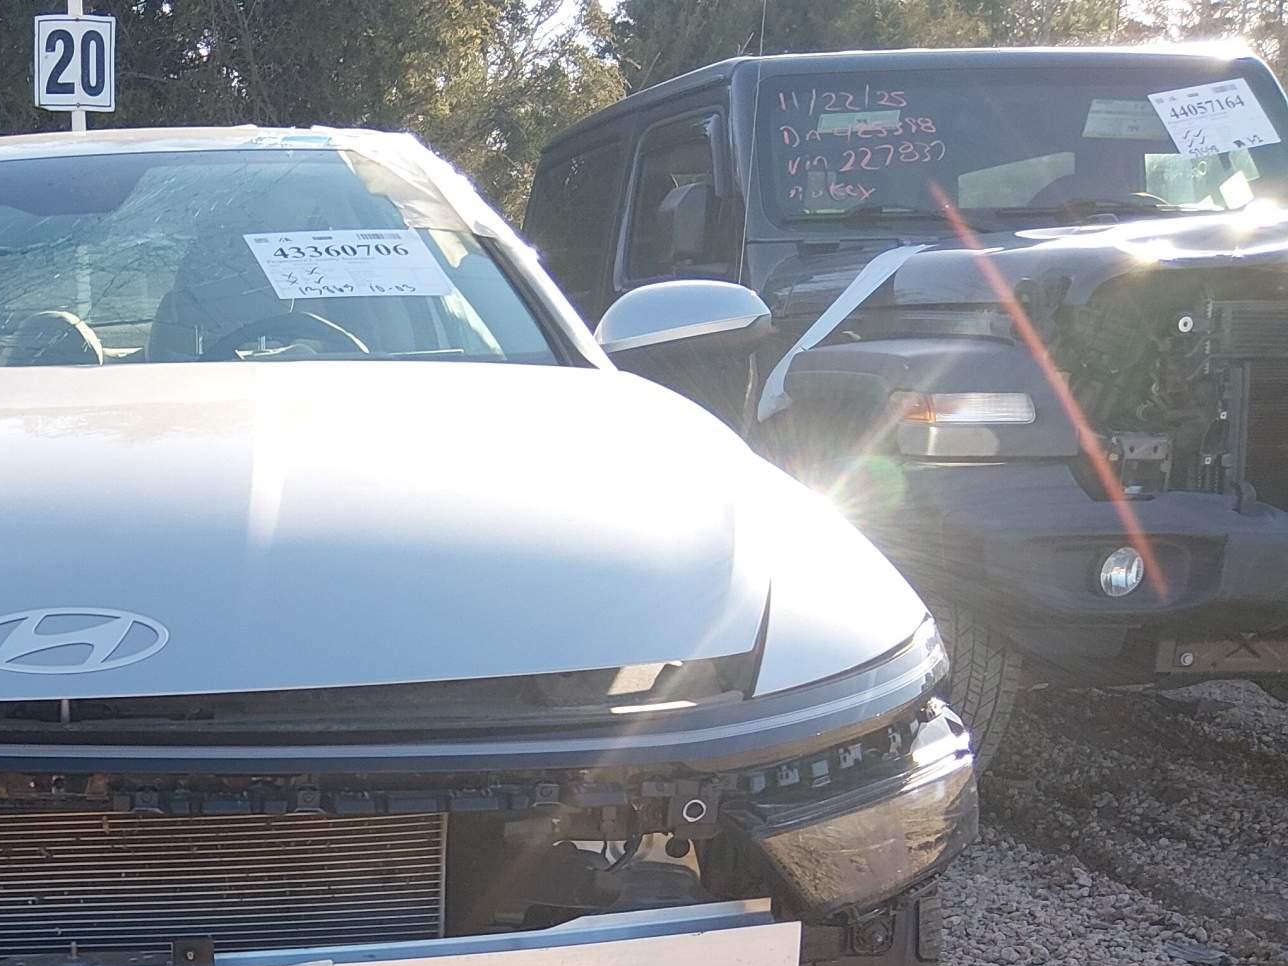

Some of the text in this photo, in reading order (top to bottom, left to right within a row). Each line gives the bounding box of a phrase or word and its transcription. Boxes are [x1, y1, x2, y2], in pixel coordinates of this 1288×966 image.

[45, 29, 105, 97] 20
[1170, 95, 1245, 119] 44057164
[273, 243, 409, 259] 43360706
